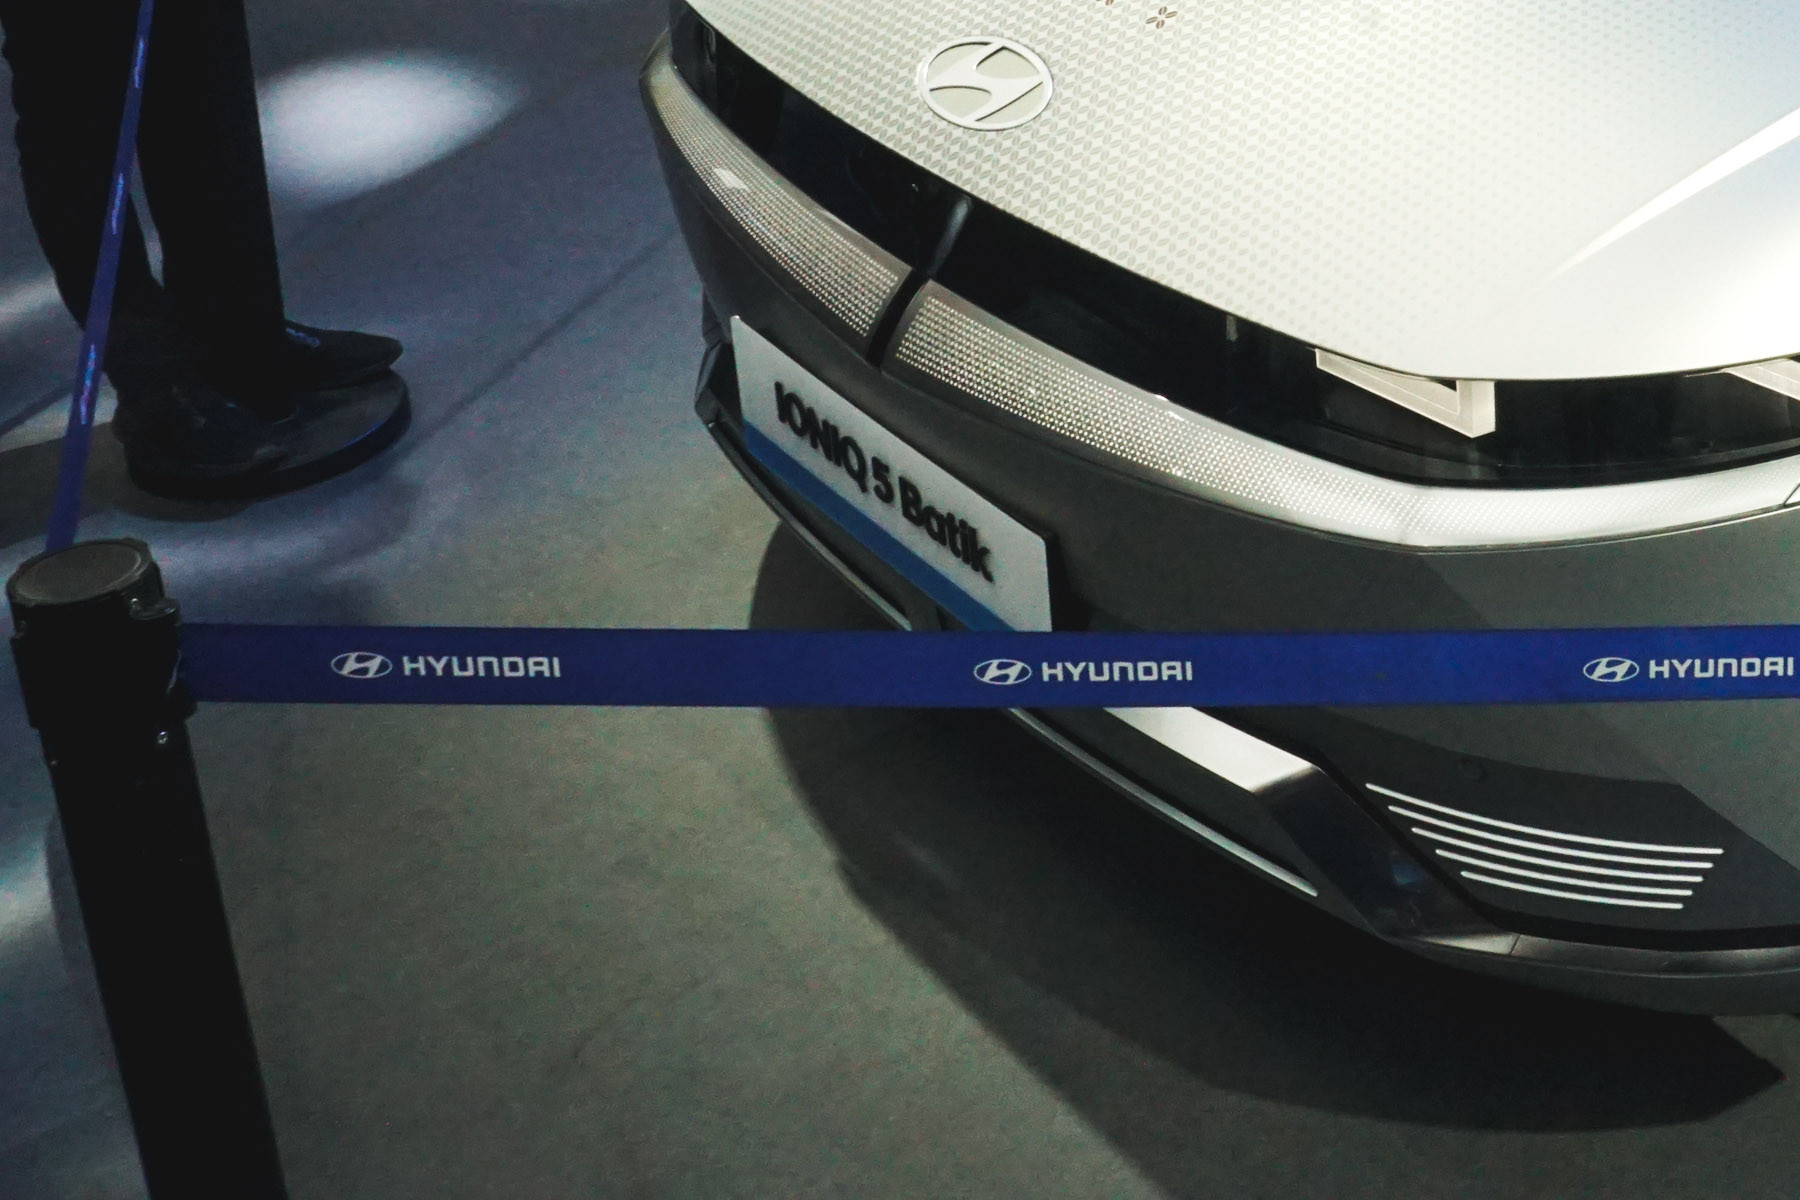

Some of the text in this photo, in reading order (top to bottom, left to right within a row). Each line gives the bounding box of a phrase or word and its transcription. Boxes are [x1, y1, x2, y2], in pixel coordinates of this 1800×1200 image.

[774, 381, 995, 584] IONIQ 5 Batik
[403, 656, 560, 677] HYUNDAI
[1042, 661, 1192, 681] HYUNDAI
[1650, 657, 1793, 678] HYUNDAI
